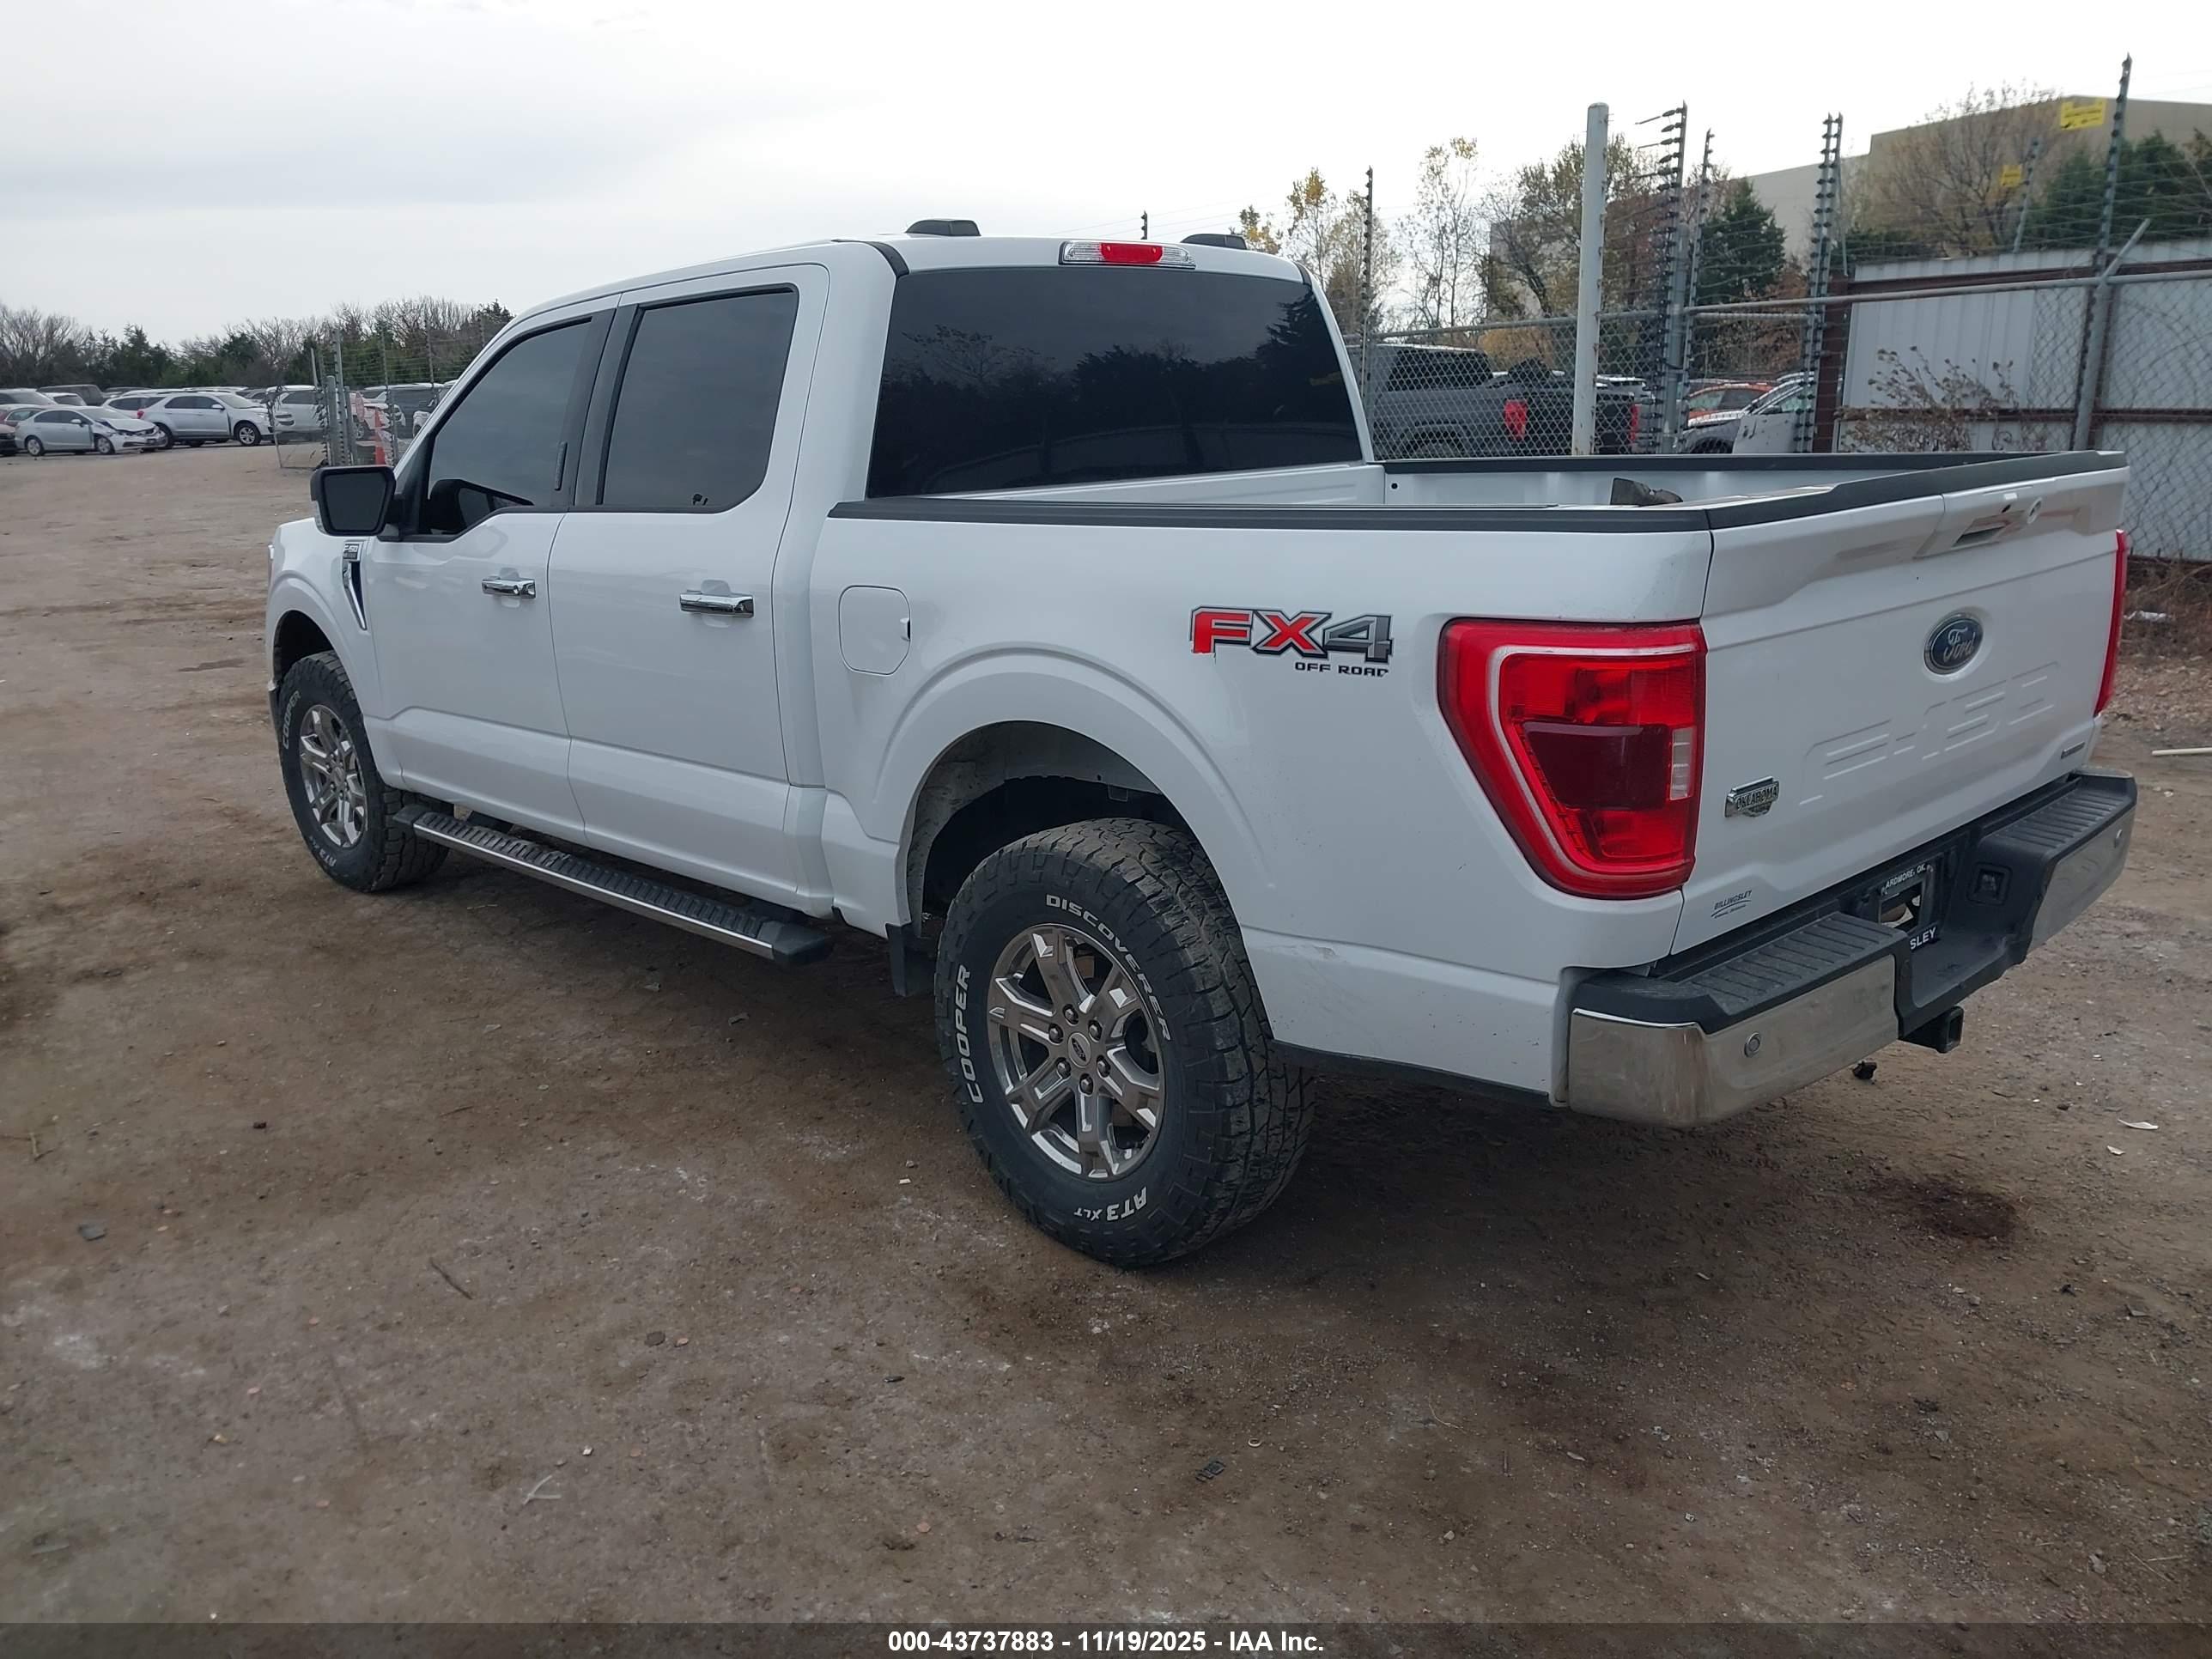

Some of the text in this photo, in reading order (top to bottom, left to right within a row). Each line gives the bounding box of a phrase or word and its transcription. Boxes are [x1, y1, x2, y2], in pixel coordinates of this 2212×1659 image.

[1190, 605, 1393, 663] FX4
[1294, 661, 1389, 678] OFF ROAD
[283, 690, 301, 750] COOPER
[1046, 893, 1172, 1041] DISCOVERER
[1910, 927, 1936, 950] SLEY
[954, 963, 984, 1103] COOPER
[1073, 1187, 1147, 1221] AT3 XLT
